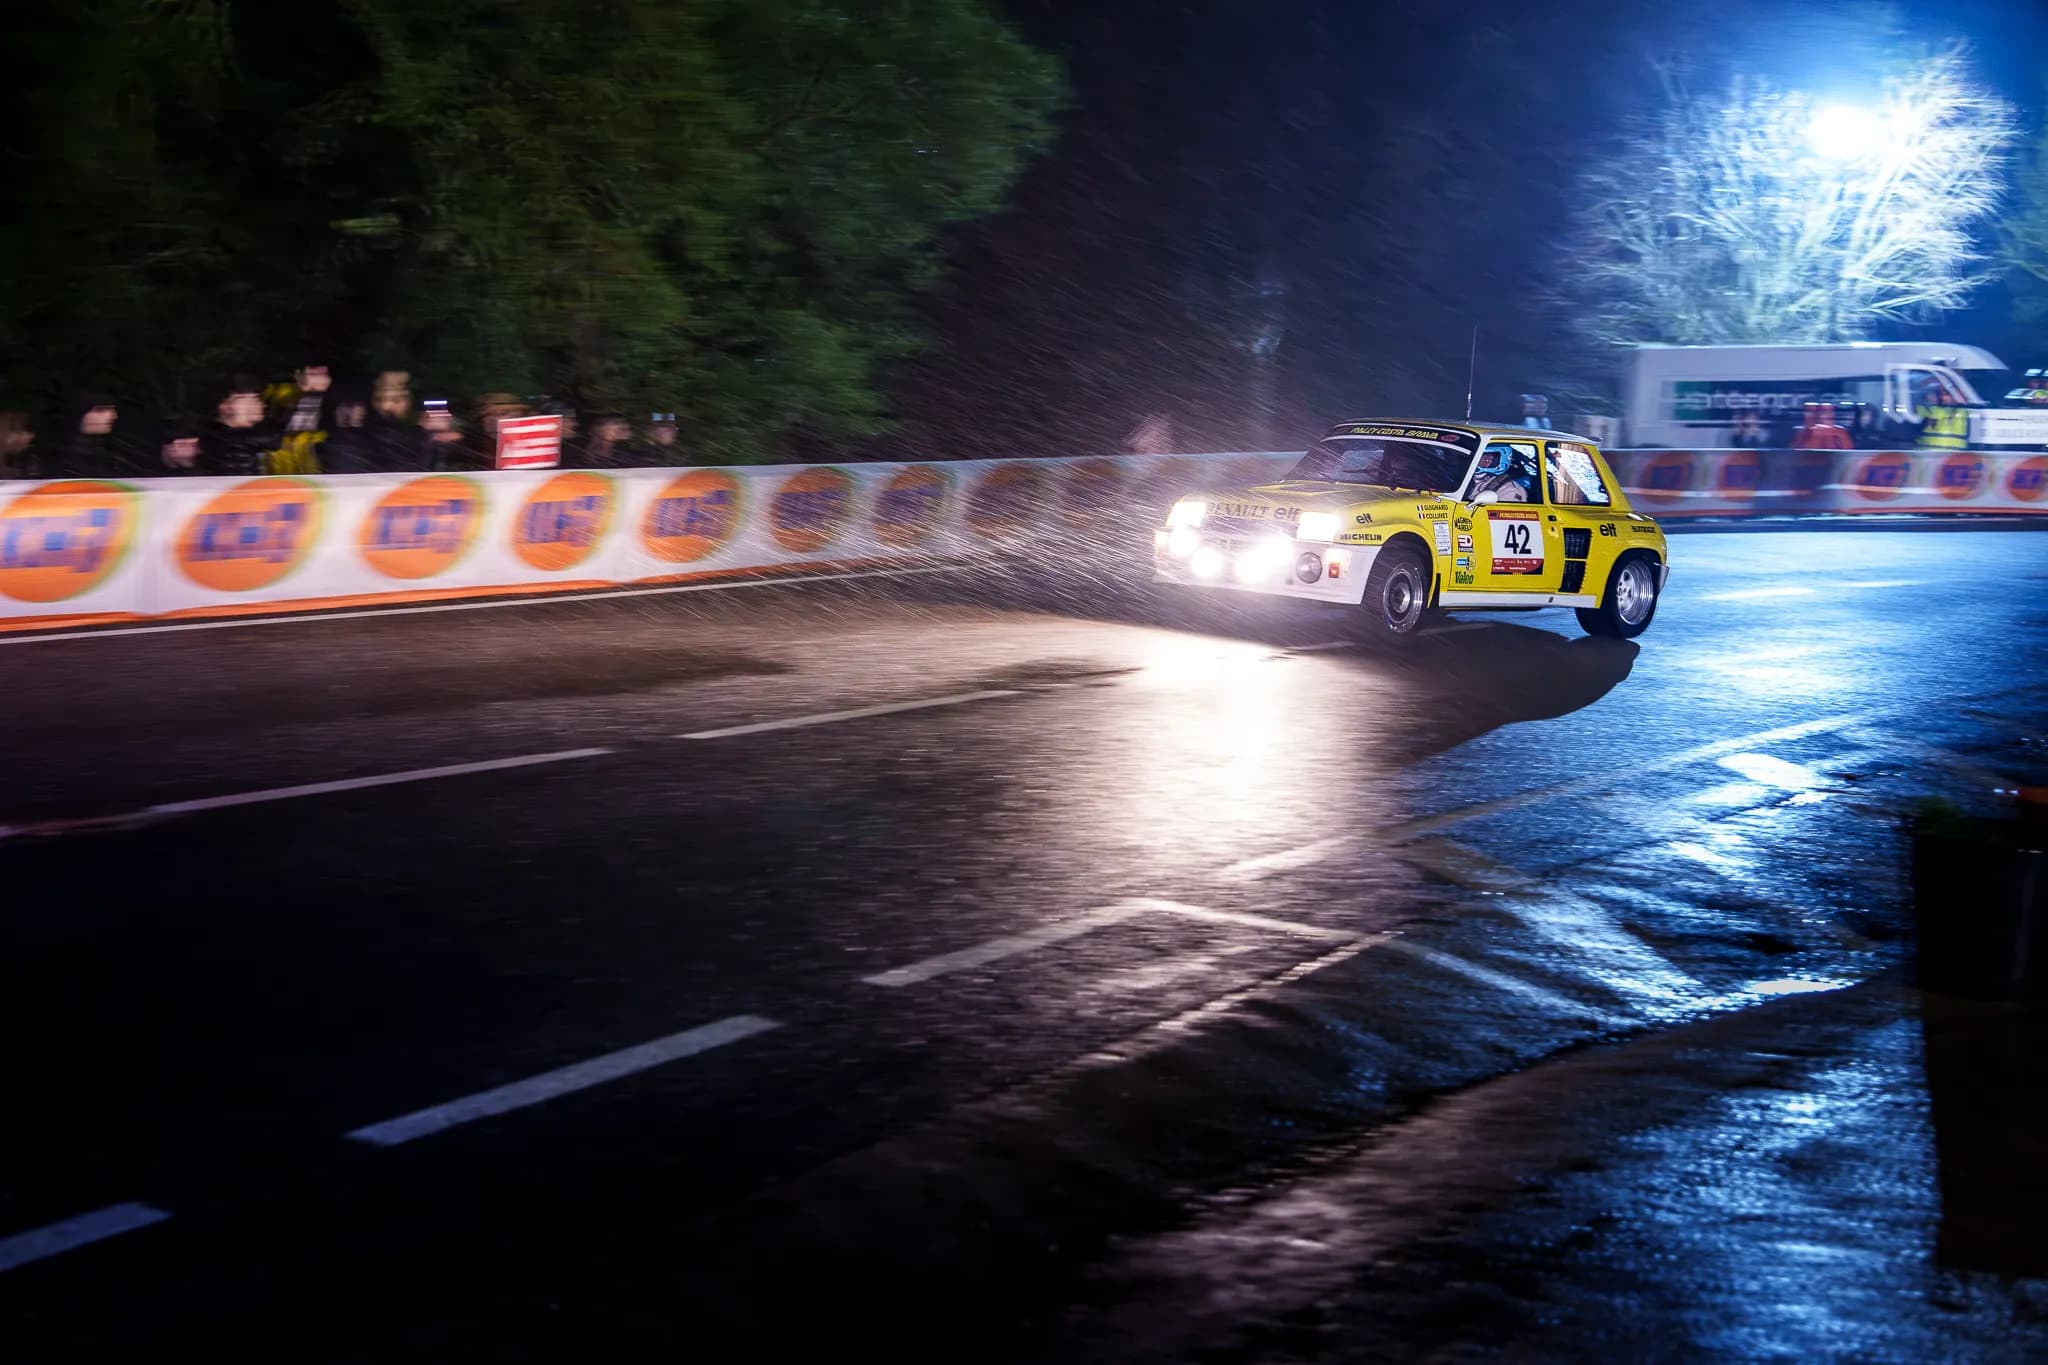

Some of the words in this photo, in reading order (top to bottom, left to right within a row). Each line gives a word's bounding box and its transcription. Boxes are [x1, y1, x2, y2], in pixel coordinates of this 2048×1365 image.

[1376, 428, 1405, 436] COSTA
[1404, 430, 1439, 440] BRAVA
[1356, 513, 1373, 524] elf
[1600, 522, 1617, 537] elf
[1340, 533, 1382, 541] MICHELIN
[1504, 524, 1532, 555] 42
[1455, 571, 1474, 585] Valeo
